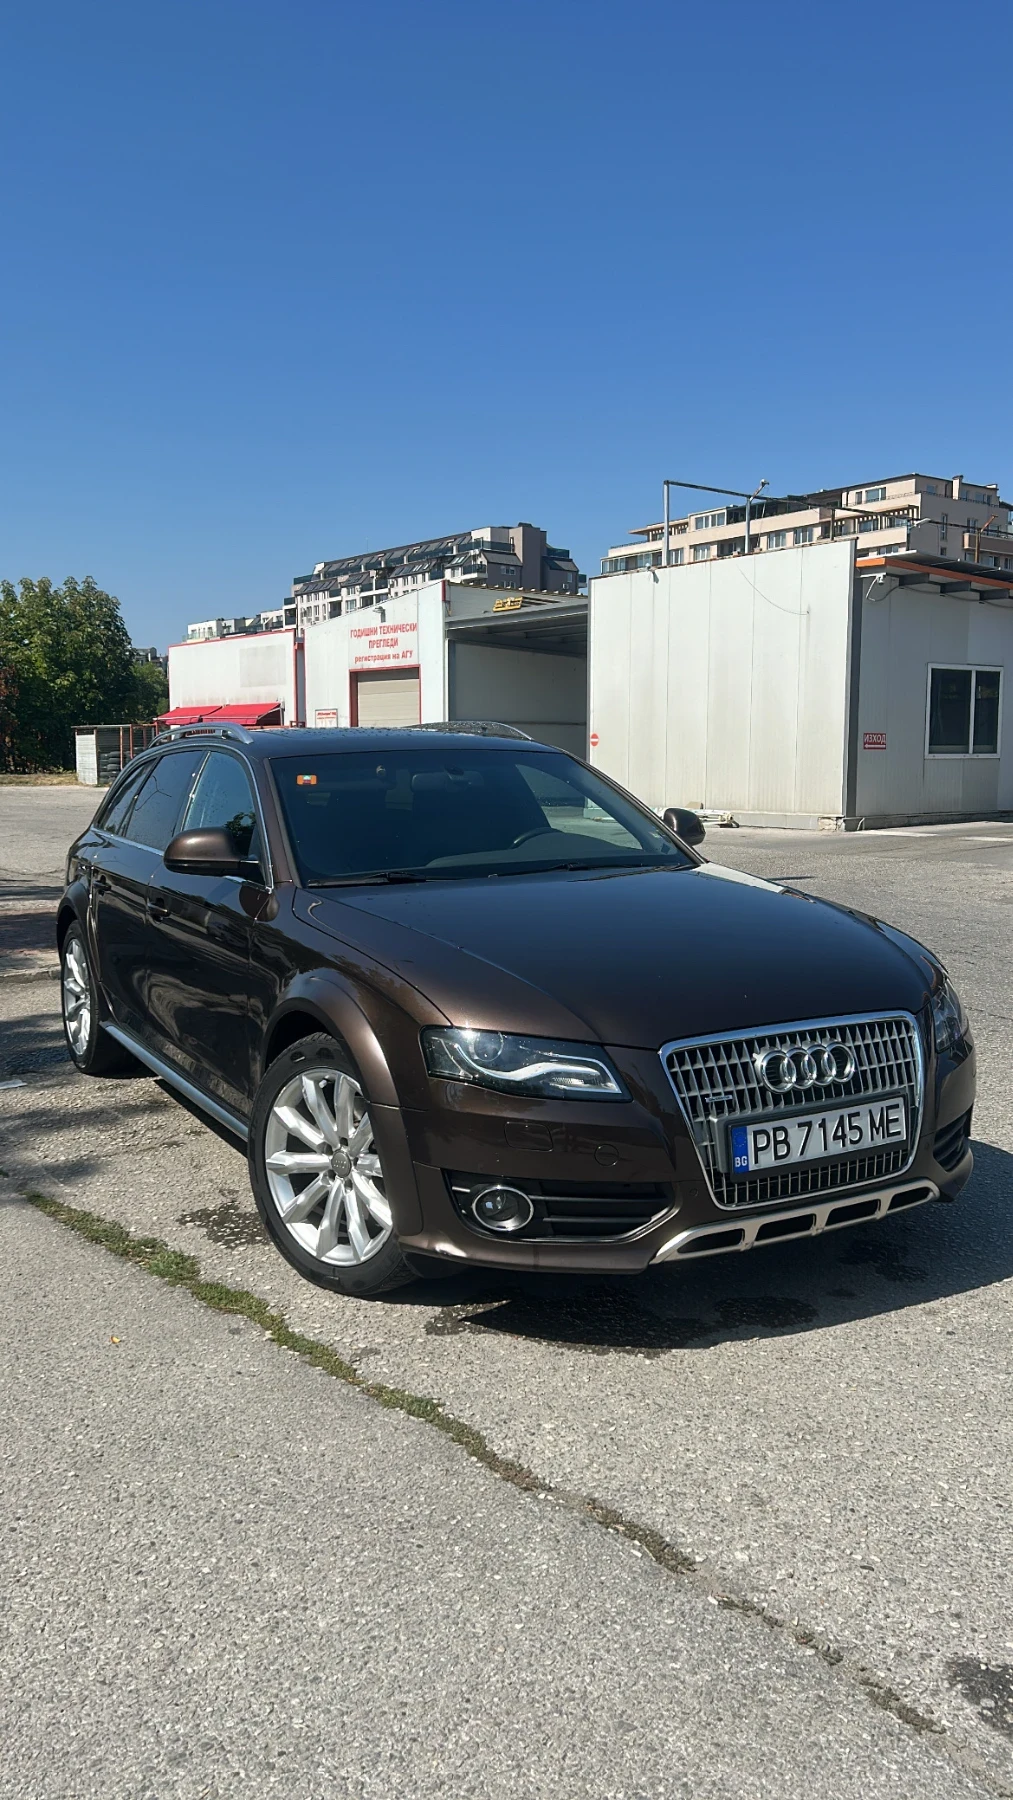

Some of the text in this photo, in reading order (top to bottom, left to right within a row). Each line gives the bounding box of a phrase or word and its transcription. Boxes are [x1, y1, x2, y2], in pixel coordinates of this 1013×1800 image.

[350, 622, 418, 639] ГОДИШНИ ТЕХНИЧЕСКИ
[368, 637, 399, 649] ПРЕГЛЕДИ
[354, 653, 391, 664] регистрация
[401, 650, 413, 659] АГУ
[864, 734, 886, 744] ИЗХОД
[753, 1104, 902, 1165] PB 7145 ME
[734, 1156, 748, 1168] BG
